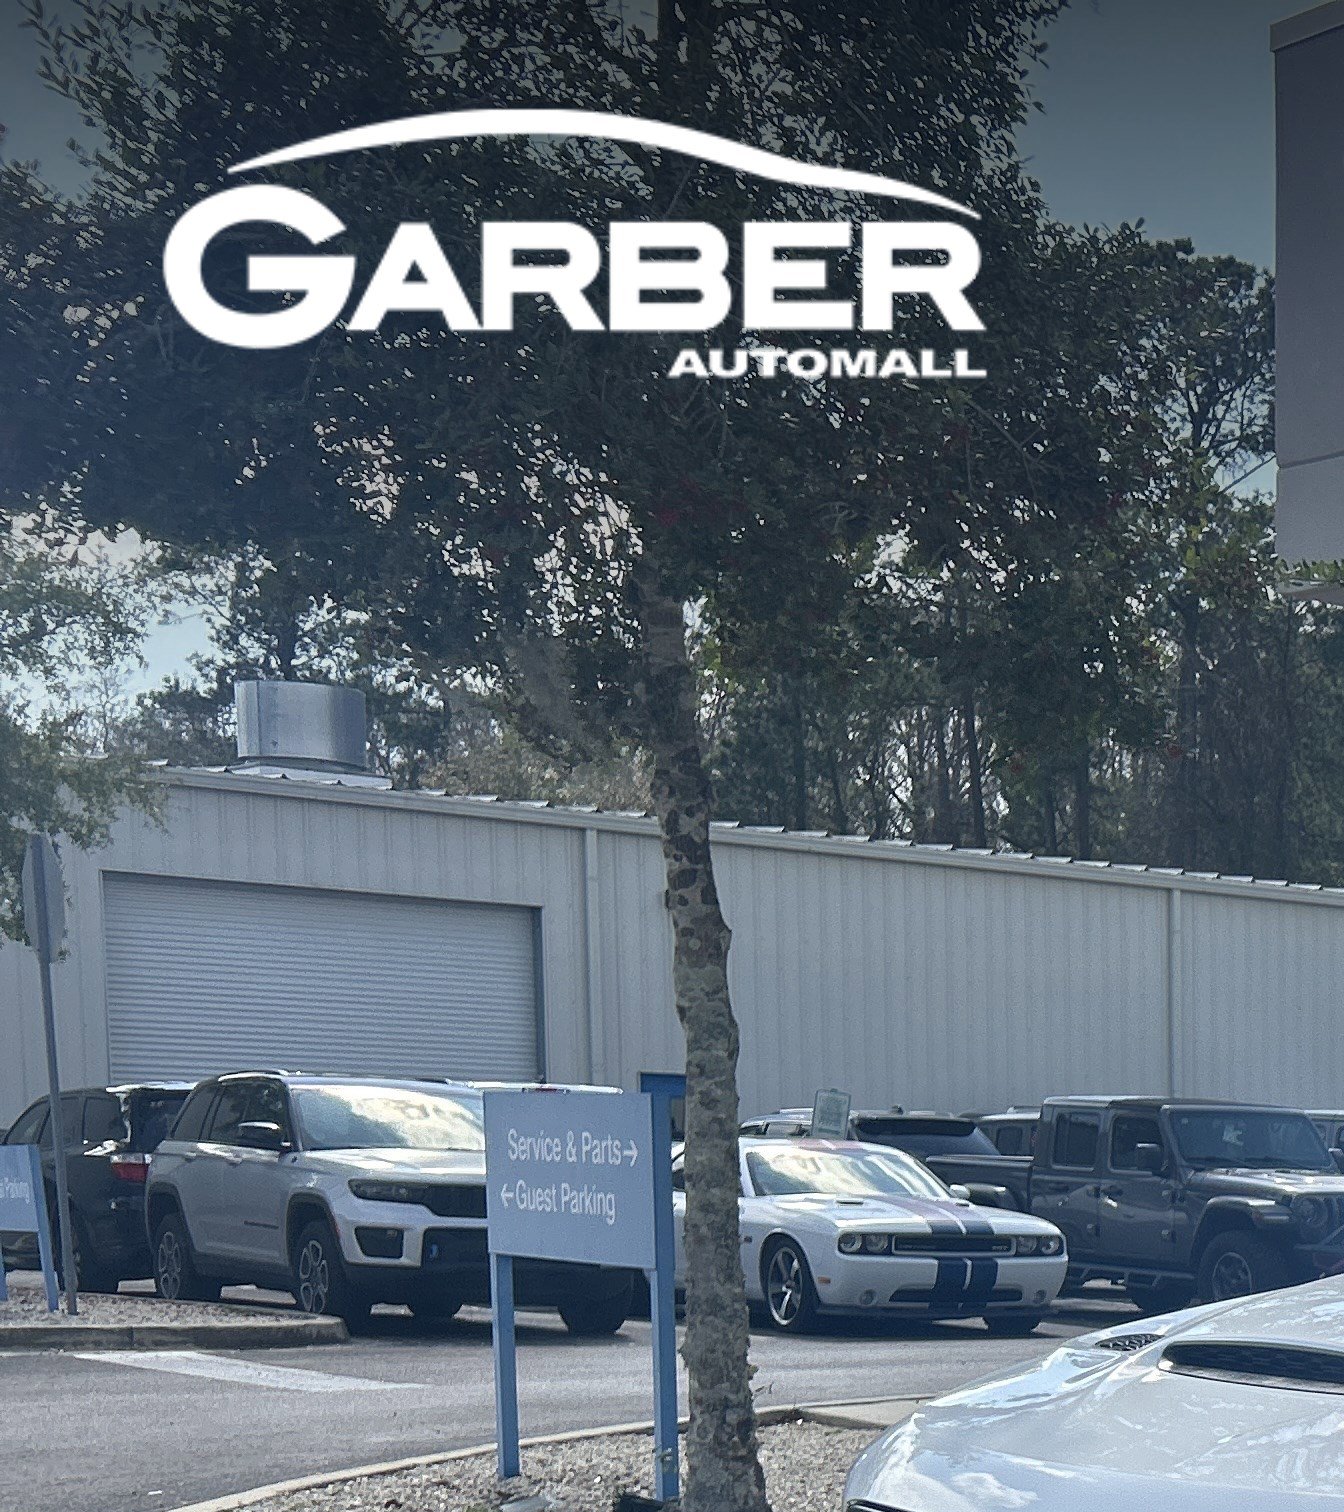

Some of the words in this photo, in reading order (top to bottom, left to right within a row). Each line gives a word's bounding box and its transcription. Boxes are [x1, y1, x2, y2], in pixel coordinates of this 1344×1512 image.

[508, 1128, 562, 1161] Service
[566, 1130, 578, 1163] &
[582, 1132, 622, 1166] Parts
[516, 1179, 557, 1213] Guest
[561, 1182, 616, 1226] Parking
